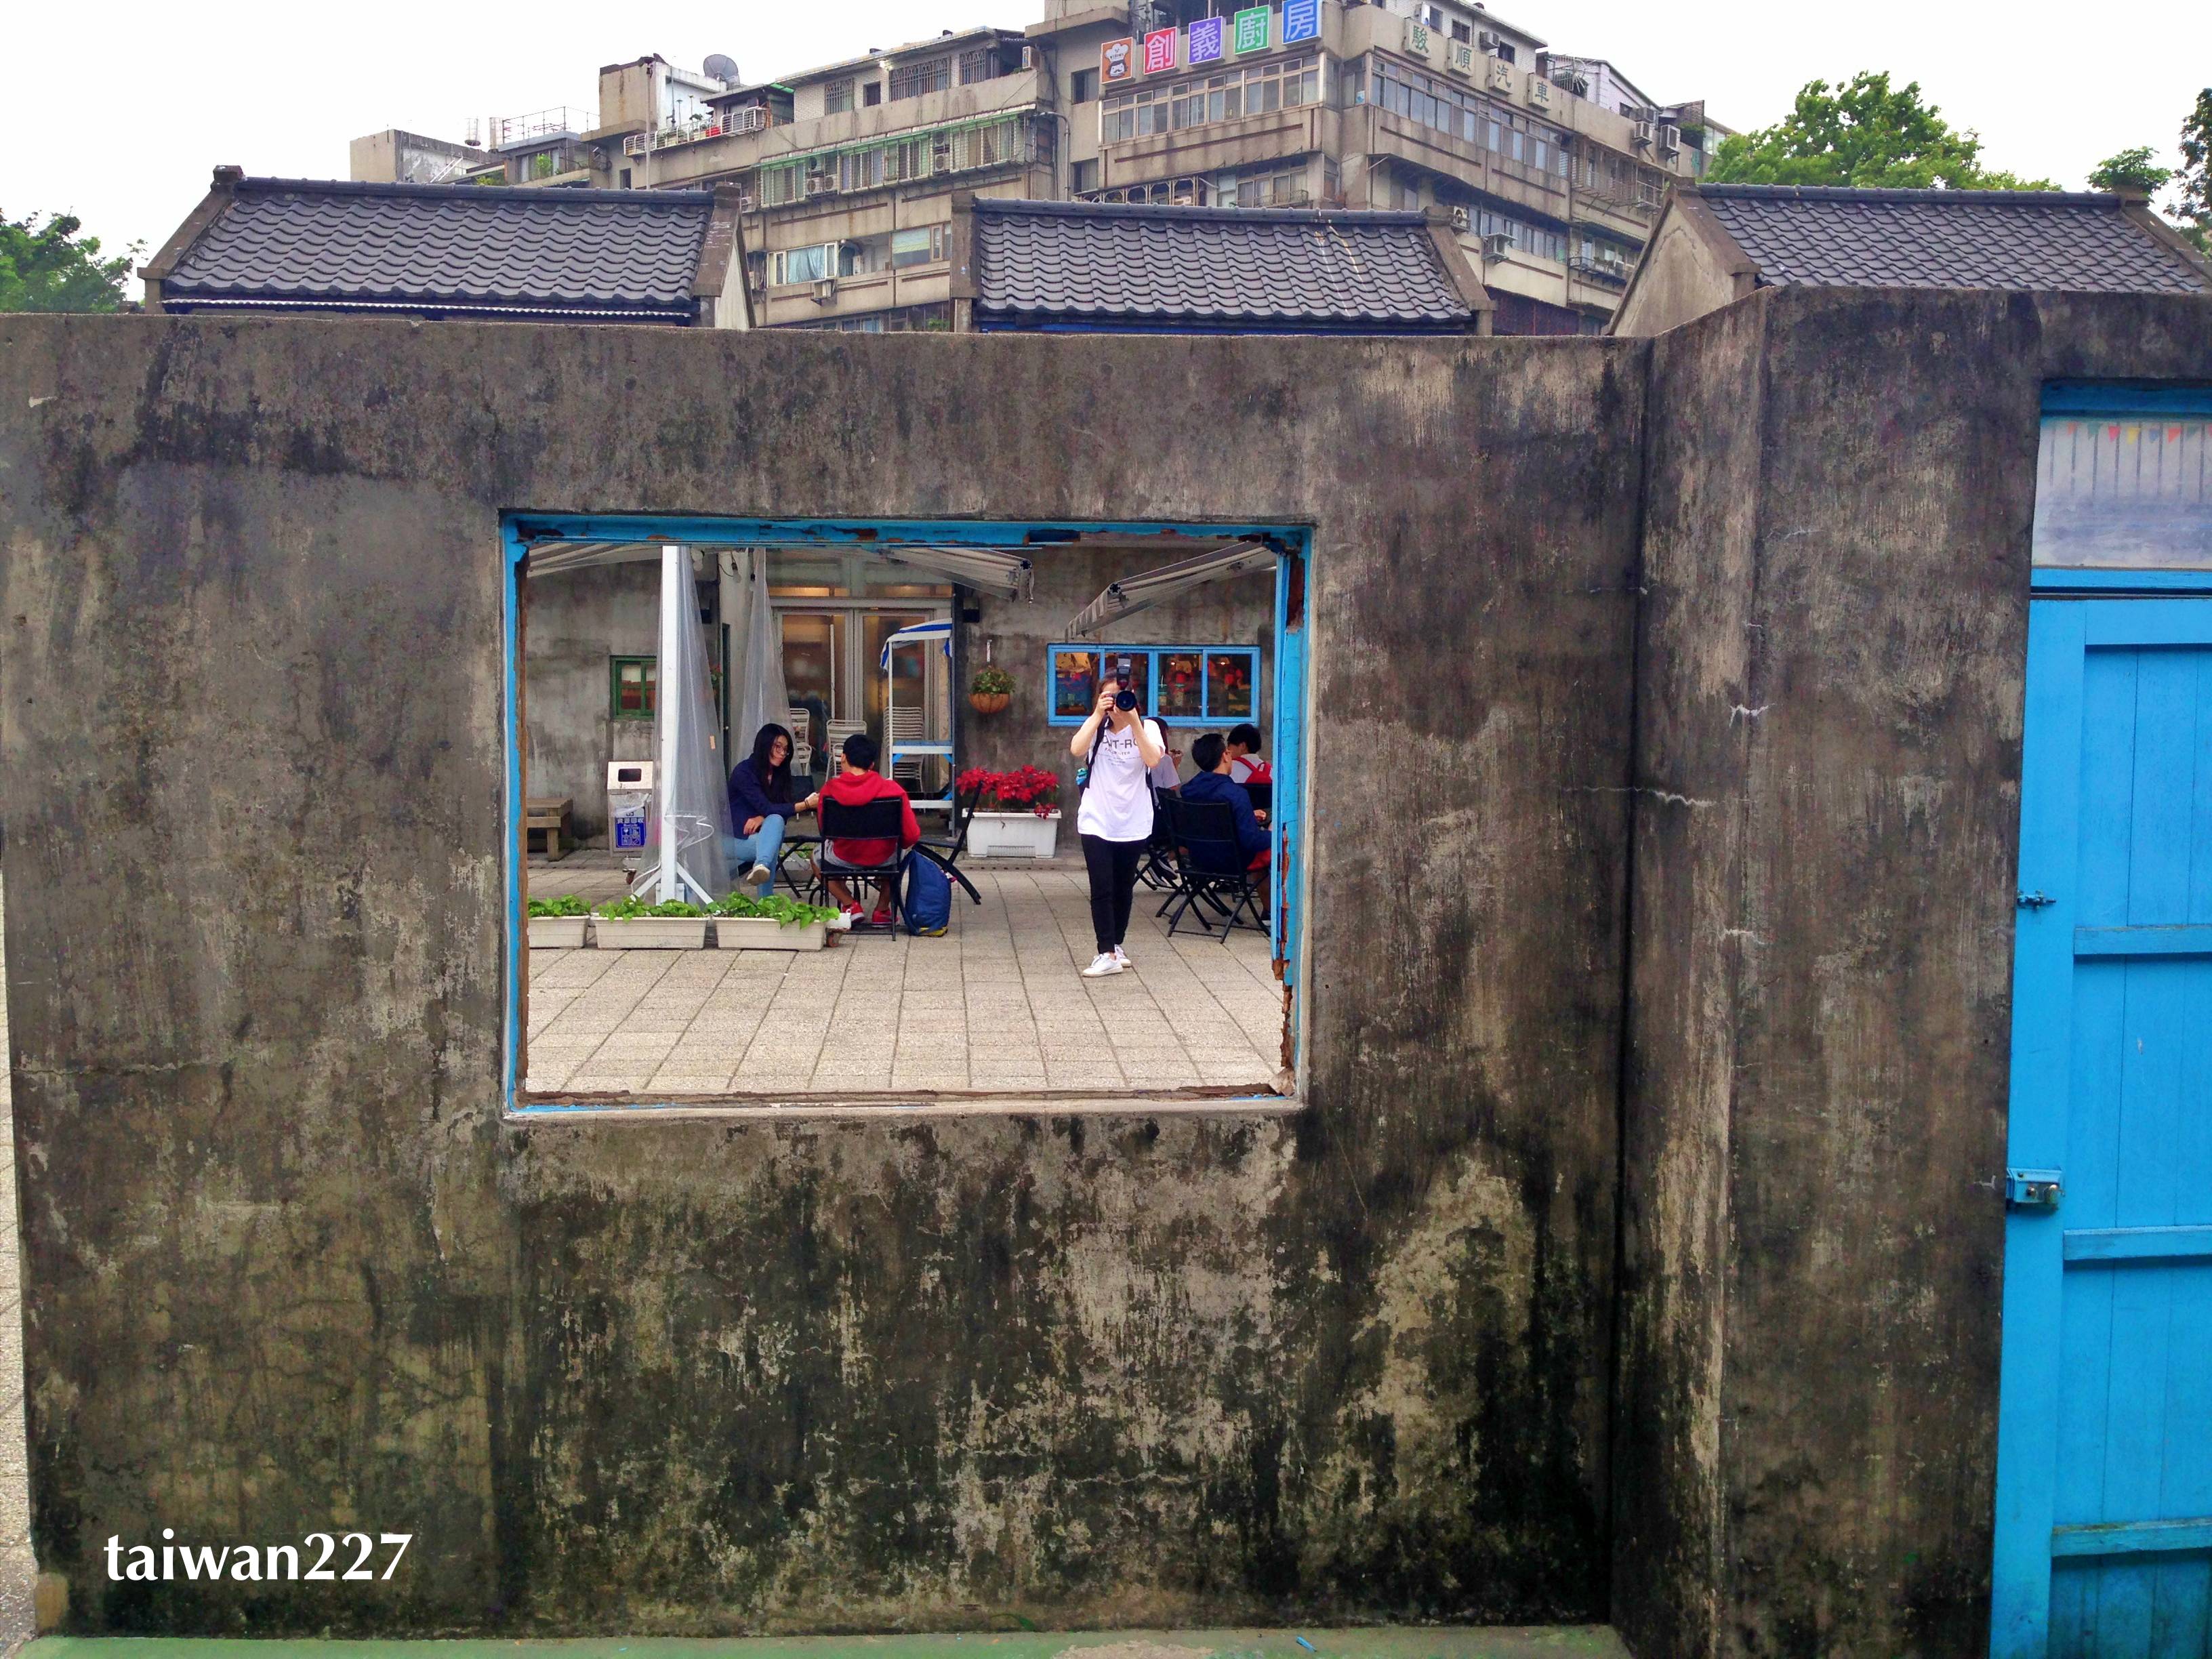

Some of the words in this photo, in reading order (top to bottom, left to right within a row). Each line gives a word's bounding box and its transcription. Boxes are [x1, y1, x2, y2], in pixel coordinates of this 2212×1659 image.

[1147, 0, 1315, 70] 創義廚房
[1411, 25, 1550, 102] 駿順汽車
